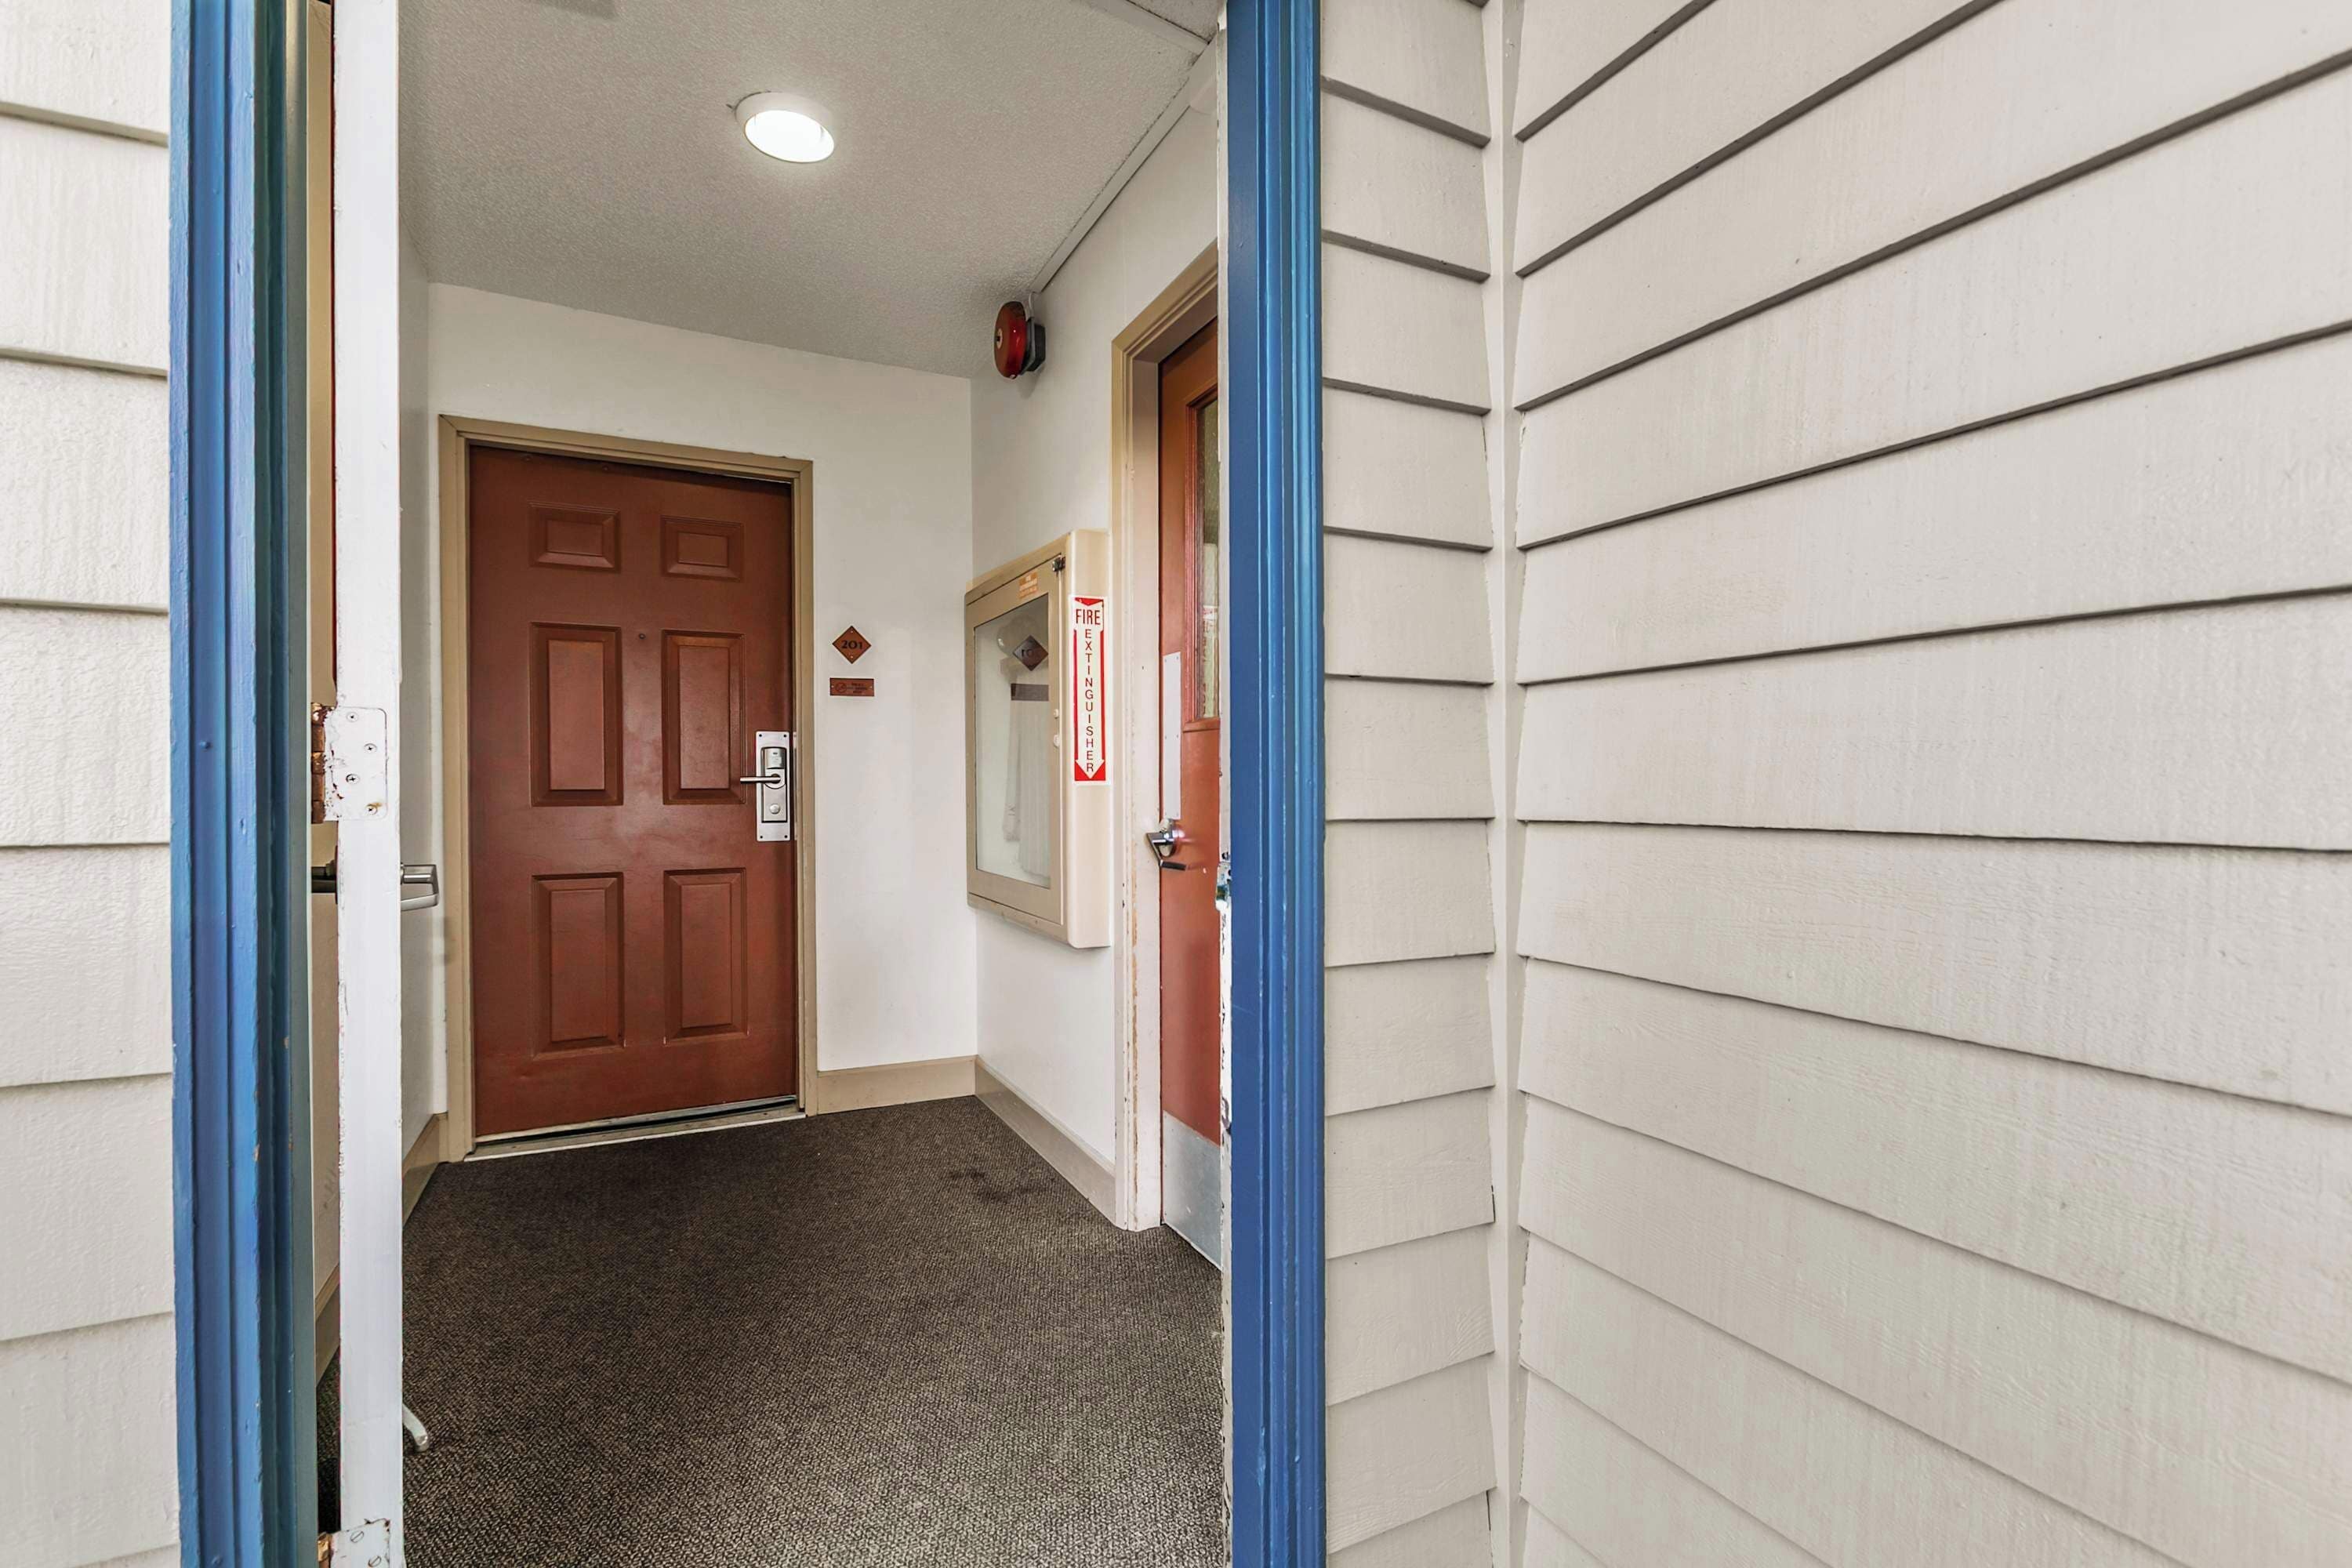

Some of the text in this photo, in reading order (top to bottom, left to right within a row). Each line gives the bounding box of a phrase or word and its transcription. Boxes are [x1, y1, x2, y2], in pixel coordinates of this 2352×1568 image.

[1075, 608, 1101, 626] FIRE
[841, 640, 862, 650] 201
[1084, 629, 1094, 772] EXTINGUISHER
